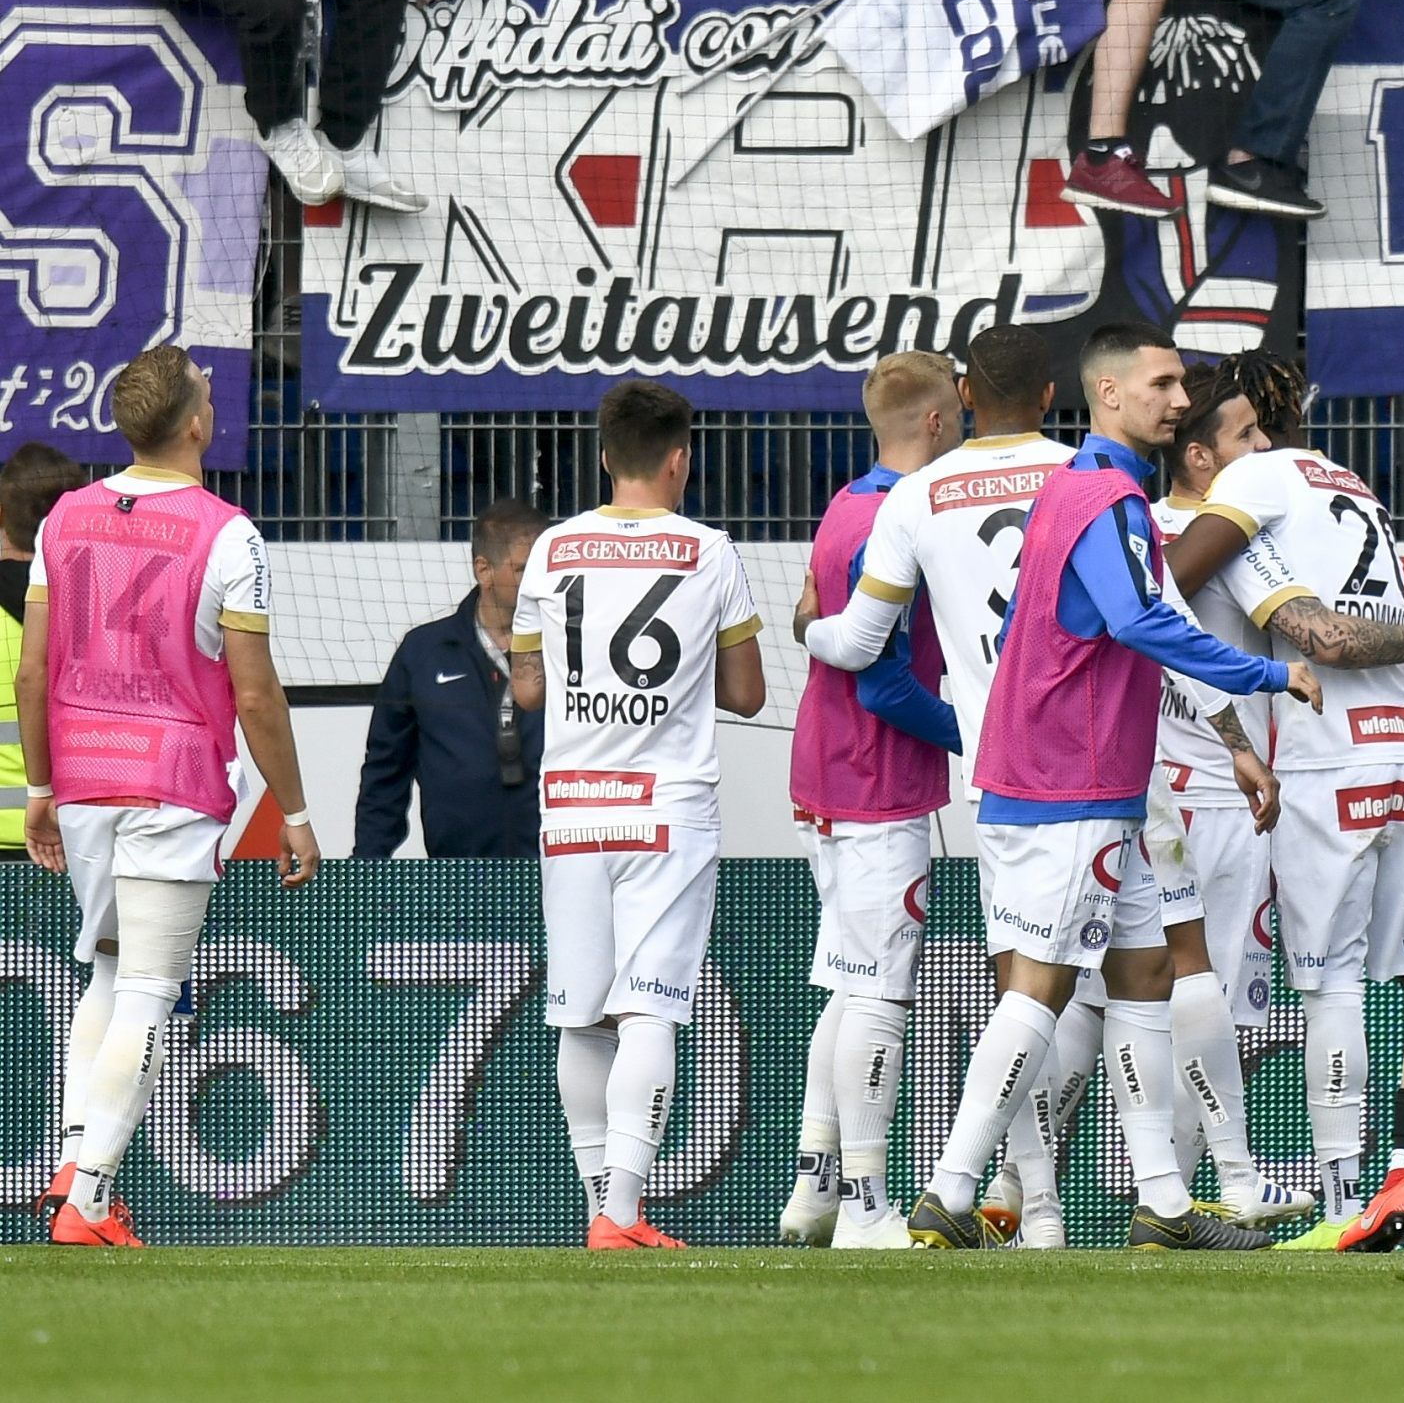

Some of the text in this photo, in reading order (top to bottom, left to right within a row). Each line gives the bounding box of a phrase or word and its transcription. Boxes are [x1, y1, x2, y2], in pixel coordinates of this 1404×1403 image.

[348, 263, 1023, 368] Zweitausend
[967, 469, 1053, 500] GENER
[246, 534, 266, 610] Verbund
[582, 539, 694, 564] GENERALI
[1241, 546, 1285, 590] rbund
[553, 574, 688, 690] 16
[566, 691, 669, 727] PROKOP
[1158, 880, 1196, 905] rbund
[992, 904, 1053, 940] Verbund
[629, 976, 691, 1002] Verbund
[141, 1023, 157, 1074] KANDL
[1120, 1043, 1142, 1095] KANDL
[1000, 1051, 1028, 1100] KANDL
[1185, 1059, 1222, 1113] KANDL
